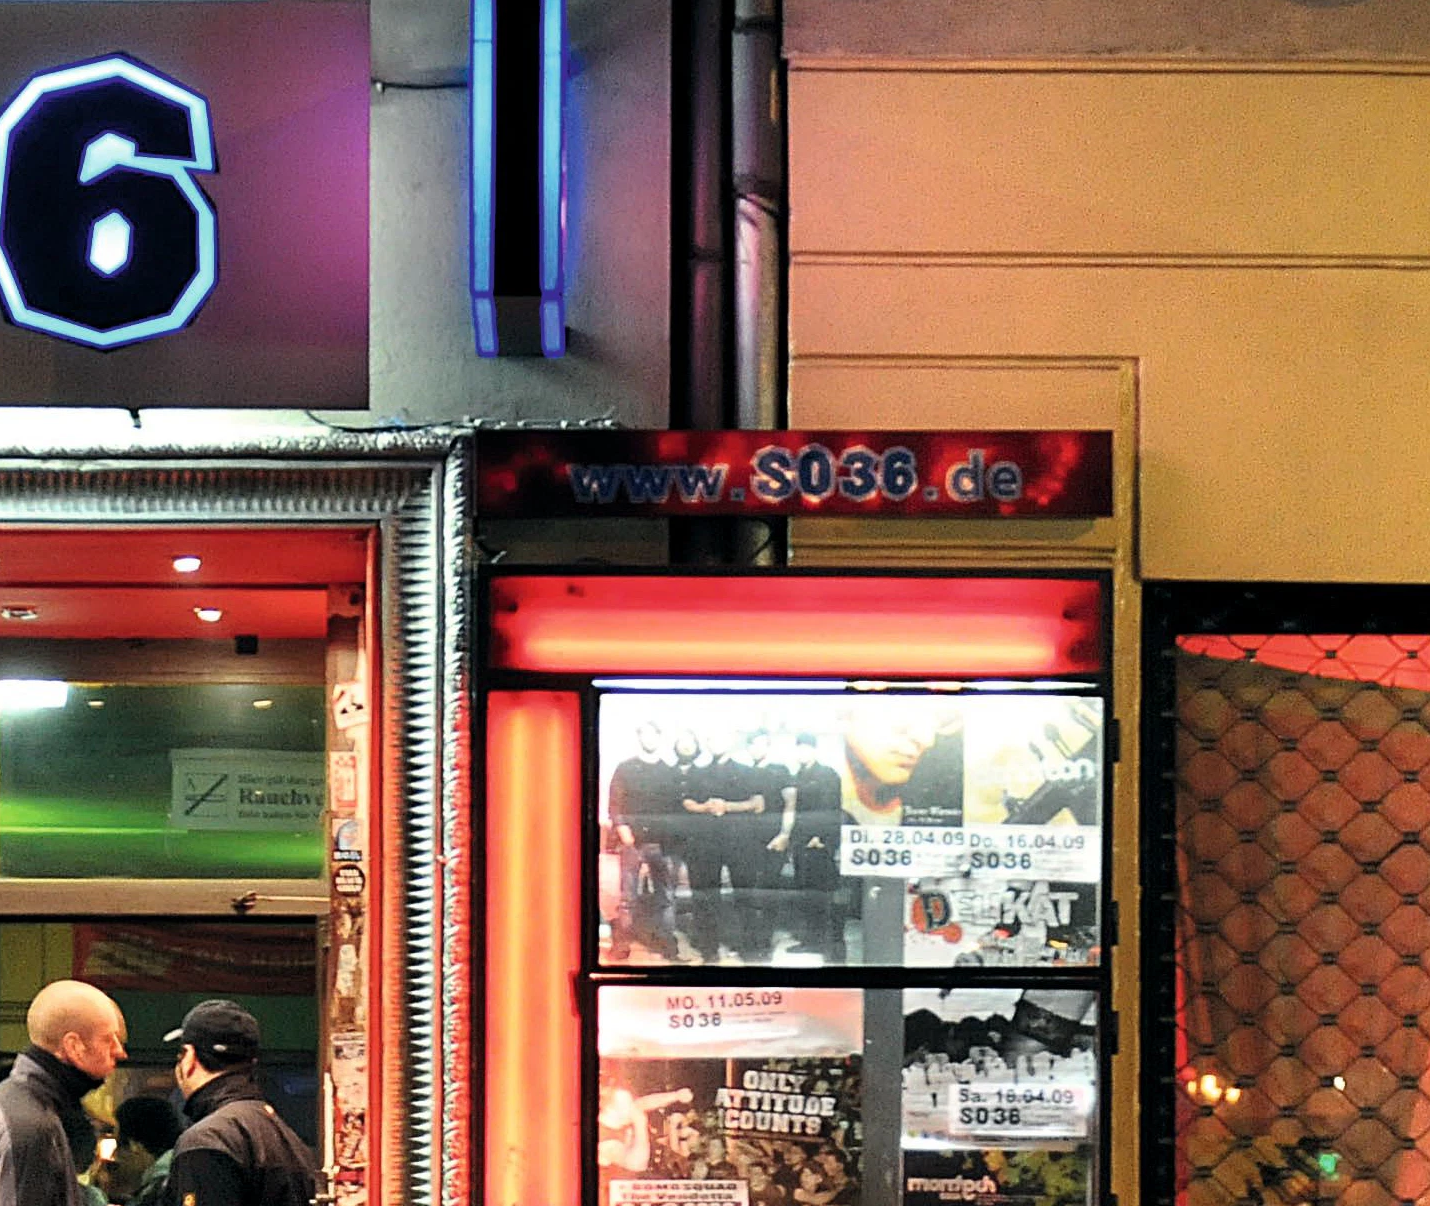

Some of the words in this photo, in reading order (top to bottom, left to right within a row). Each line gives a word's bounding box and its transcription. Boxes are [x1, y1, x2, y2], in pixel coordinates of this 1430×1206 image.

[568, 444, 1022, 503] www.SO36.de
[883, 831, 964, 845] 28.04.09
[1008, 835, 1085, 849] 16.04.09
[709, 992, 783, 1008] 11.05.09
[743, 1070, 808, 1093] ONLY
[716, 1087, 836, 1117] ATTITUDE
[724, 1108, 821, 1135] COUNTS
